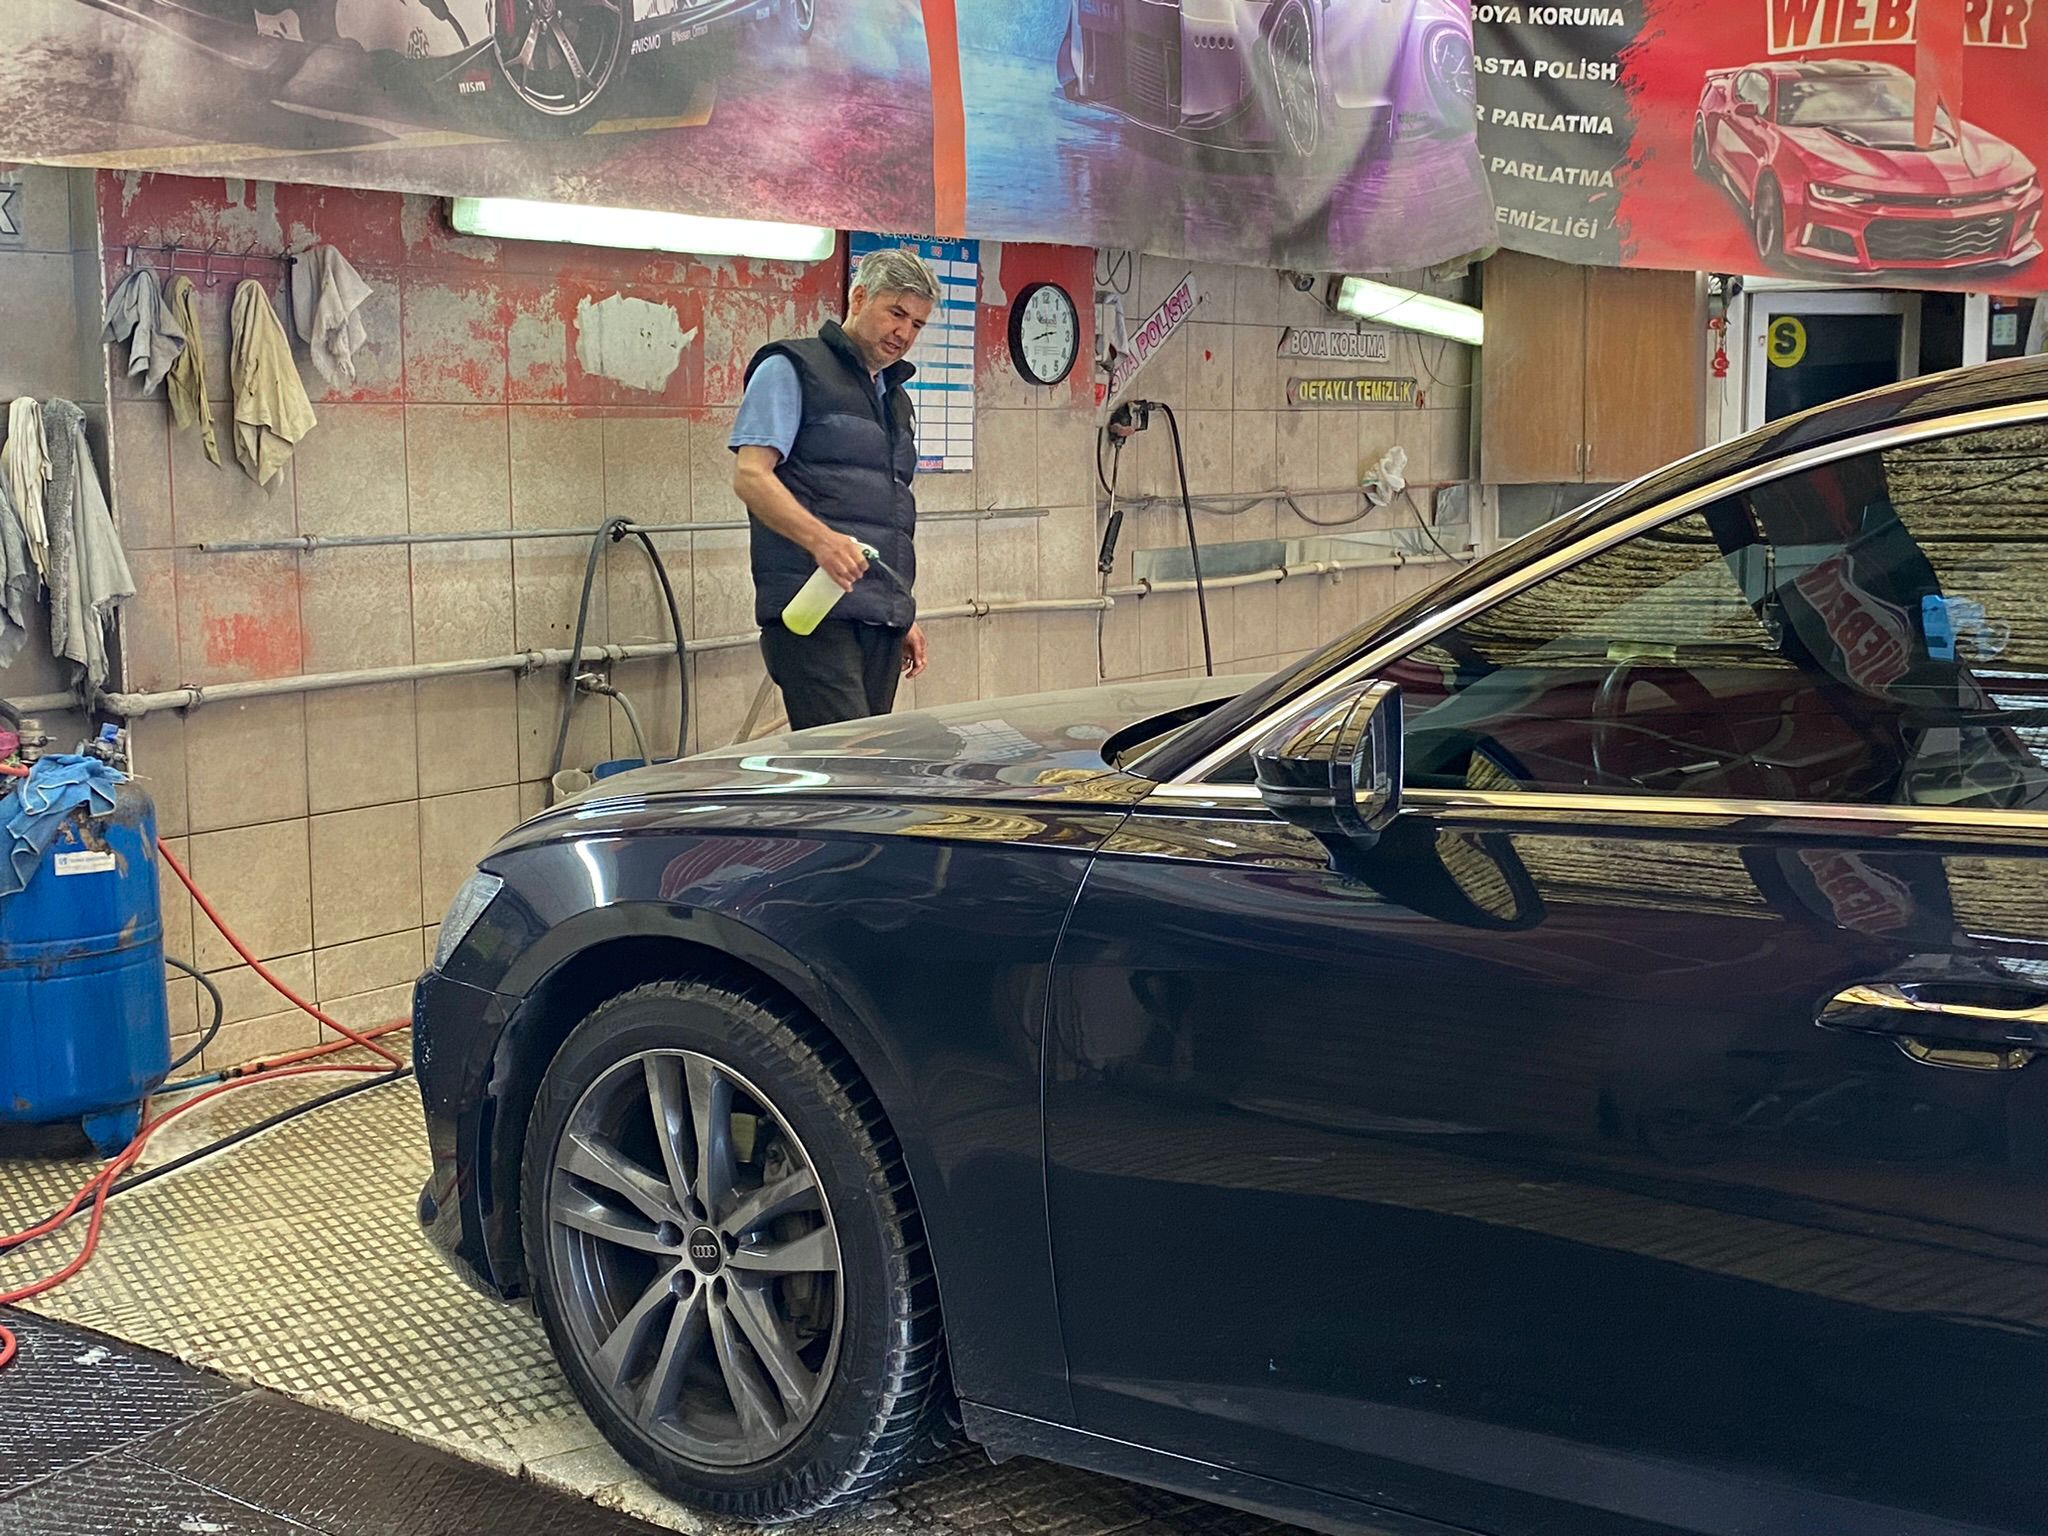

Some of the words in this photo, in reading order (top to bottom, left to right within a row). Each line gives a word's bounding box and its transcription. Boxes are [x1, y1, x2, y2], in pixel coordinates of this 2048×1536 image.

[1472, 5, 1521, 24] BOYA
[1528, 6, 1625, 26] KORUMA
[1768, 0, 2028, 54] WIEBRR
[630, 33, 661, 55] #NISMO
[1533, 58, 1618, 81] POLİSH
[1491, 108, 1614, 135] PARLATMA
[1490, 157, 1614, 188] PARLATMA
[1290, 329, 1328, 356] BOYA
[1330, 332, 1386, 359] KORUMA
[1774, 322, 1797, 355] S
[1299, 380, 1353, 402] DETAYLI
[1356, 380, 1413, 402] TEMİZLİK
